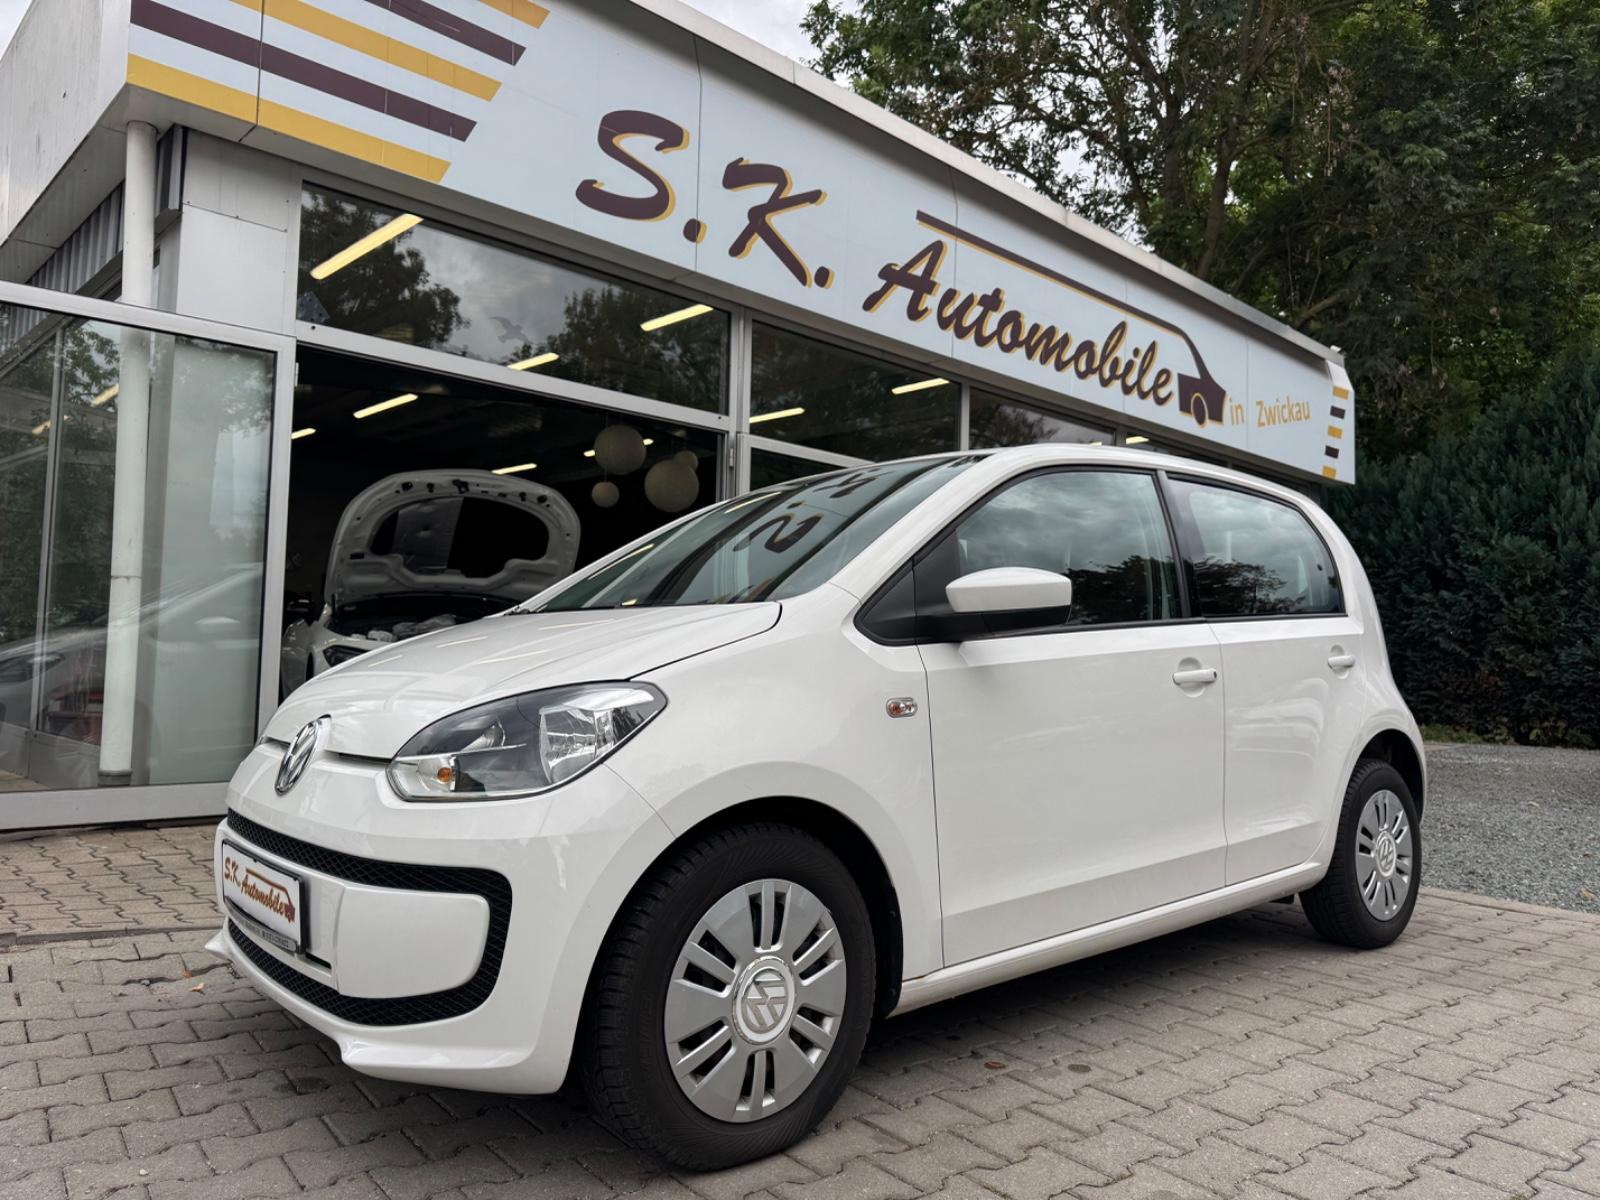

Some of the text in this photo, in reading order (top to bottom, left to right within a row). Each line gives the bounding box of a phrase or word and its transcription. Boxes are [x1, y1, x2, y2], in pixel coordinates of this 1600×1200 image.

[861, 239, 1176, 407] Automobile
[1229, 395, 1311, 428] in Zwickau
[241, 874, 285, 916] Automobile
